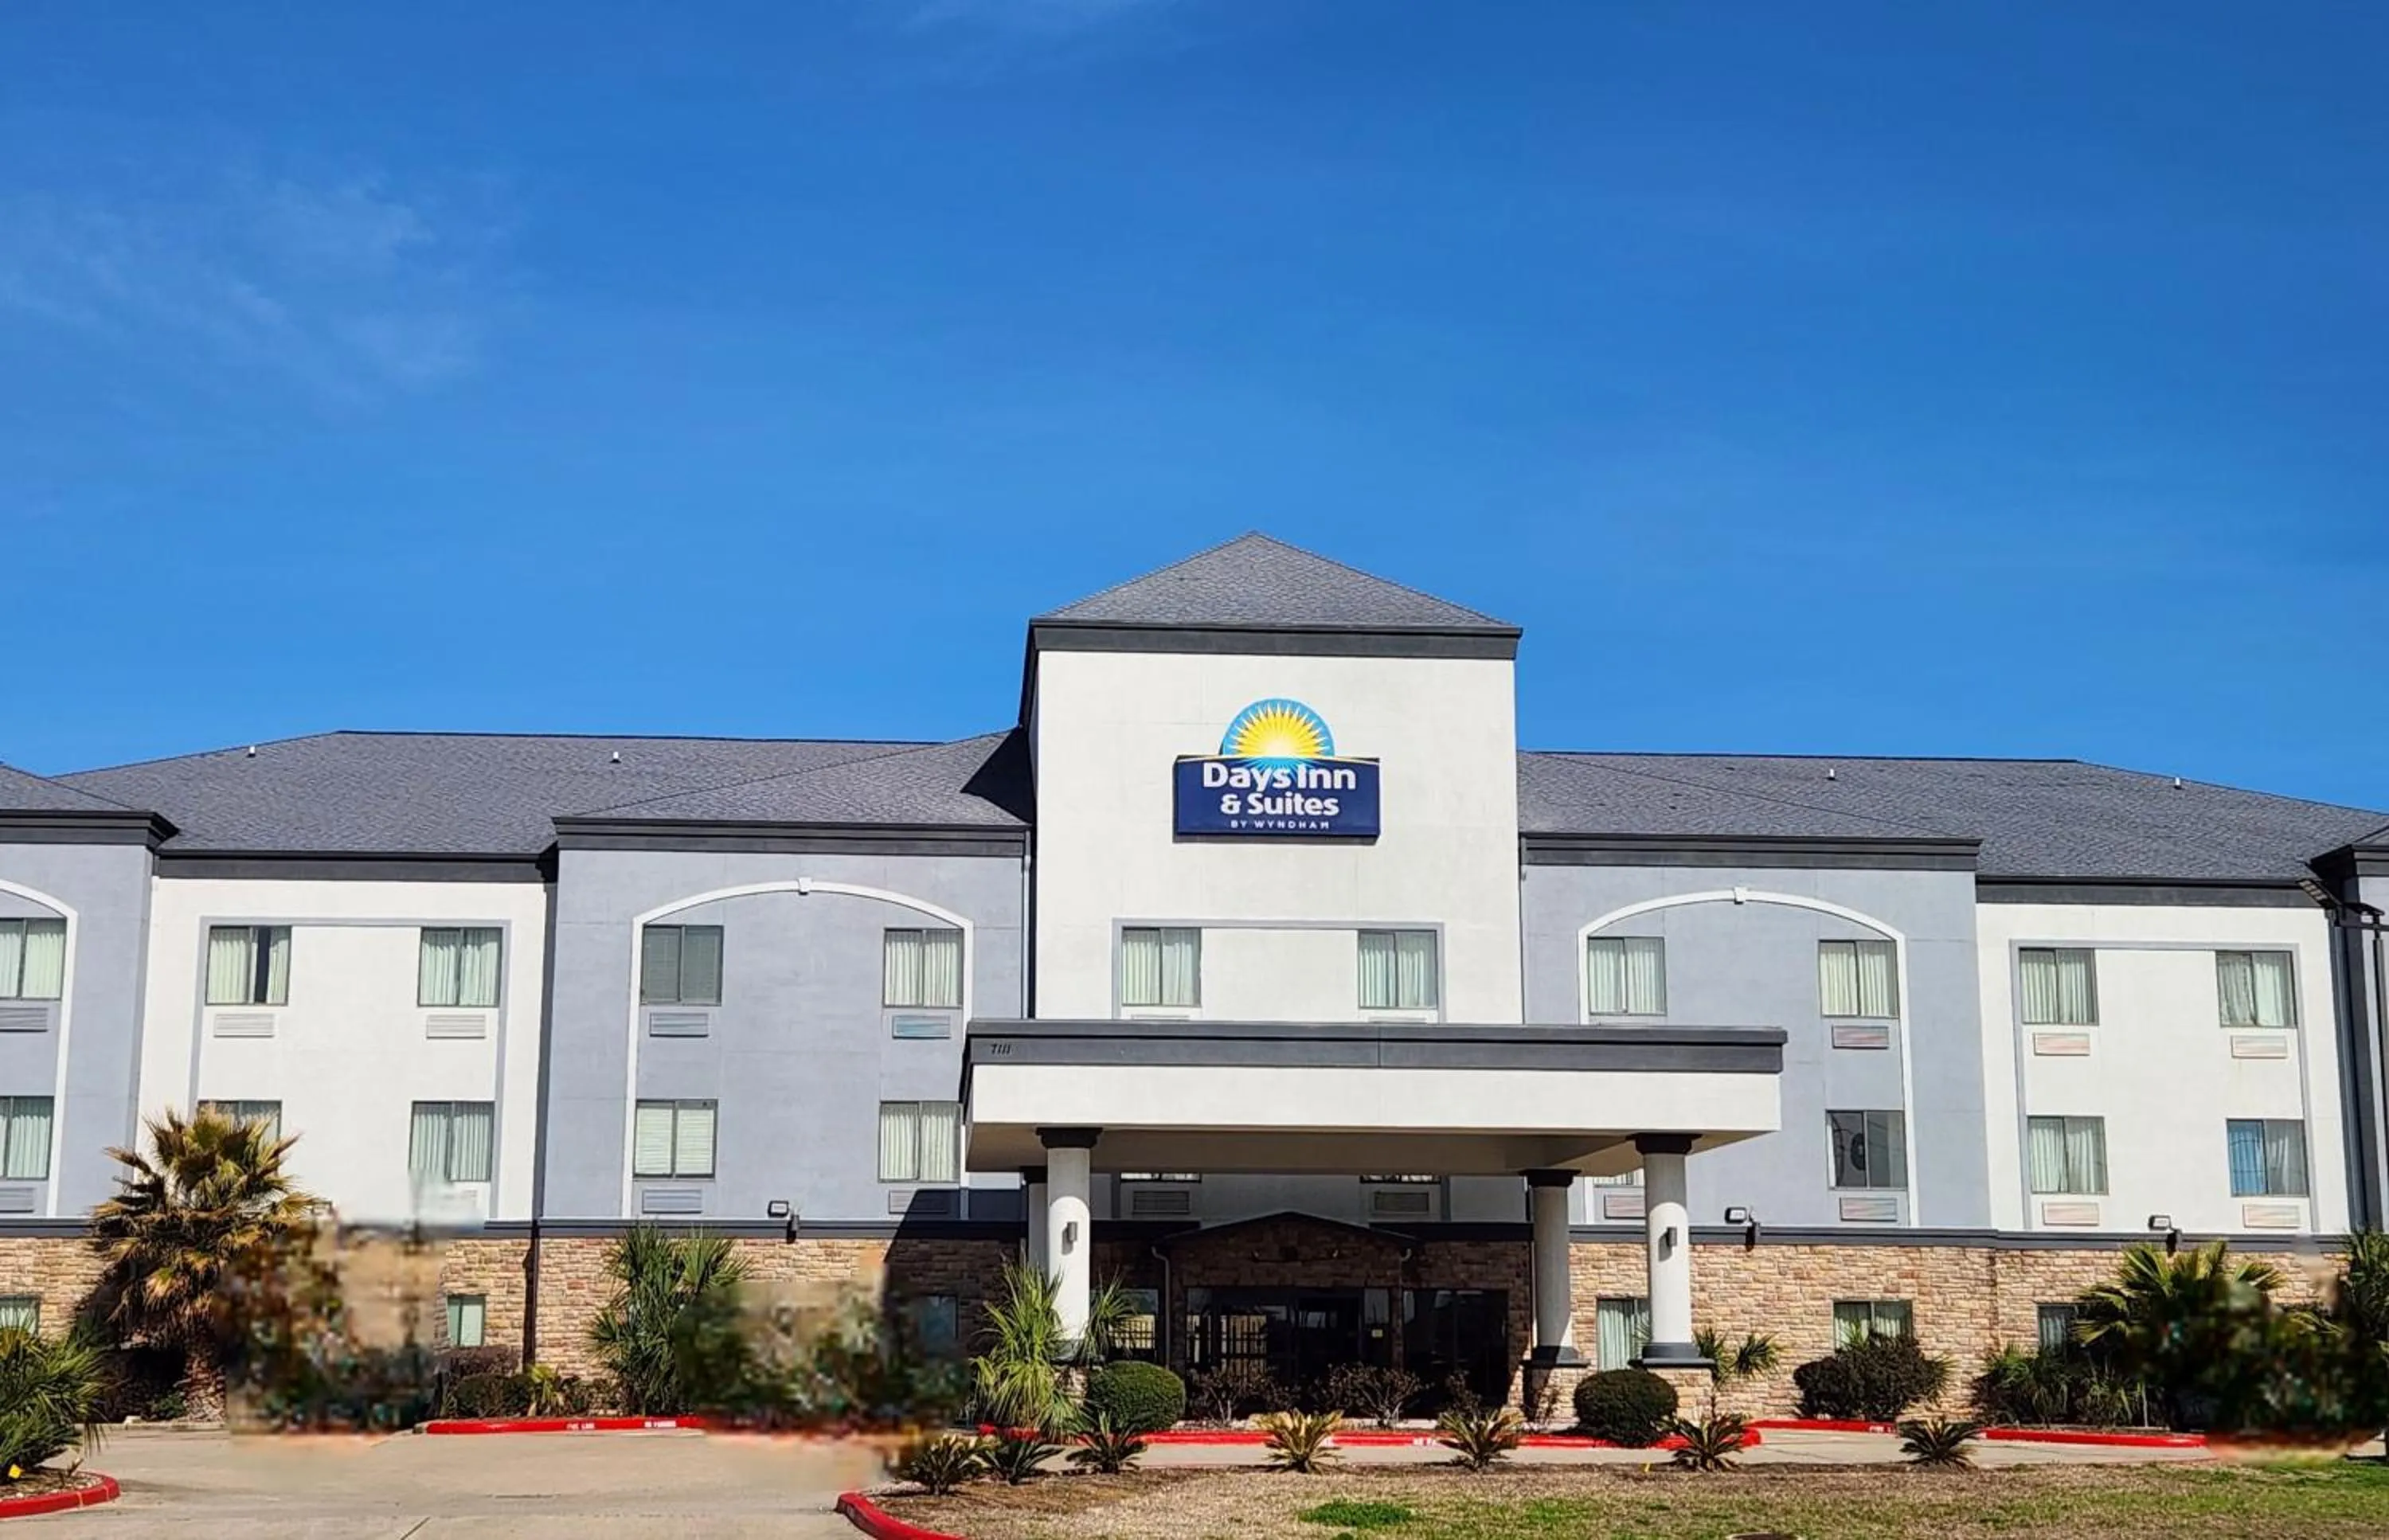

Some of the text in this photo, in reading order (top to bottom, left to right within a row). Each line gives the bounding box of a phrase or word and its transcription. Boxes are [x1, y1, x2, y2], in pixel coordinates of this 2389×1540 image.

[1202, 762, 1357, 792] Days Inn
[1220, 791, 1340, 816] & Suites
[1230, 819, 1330, 830] BY WYNDHAM
